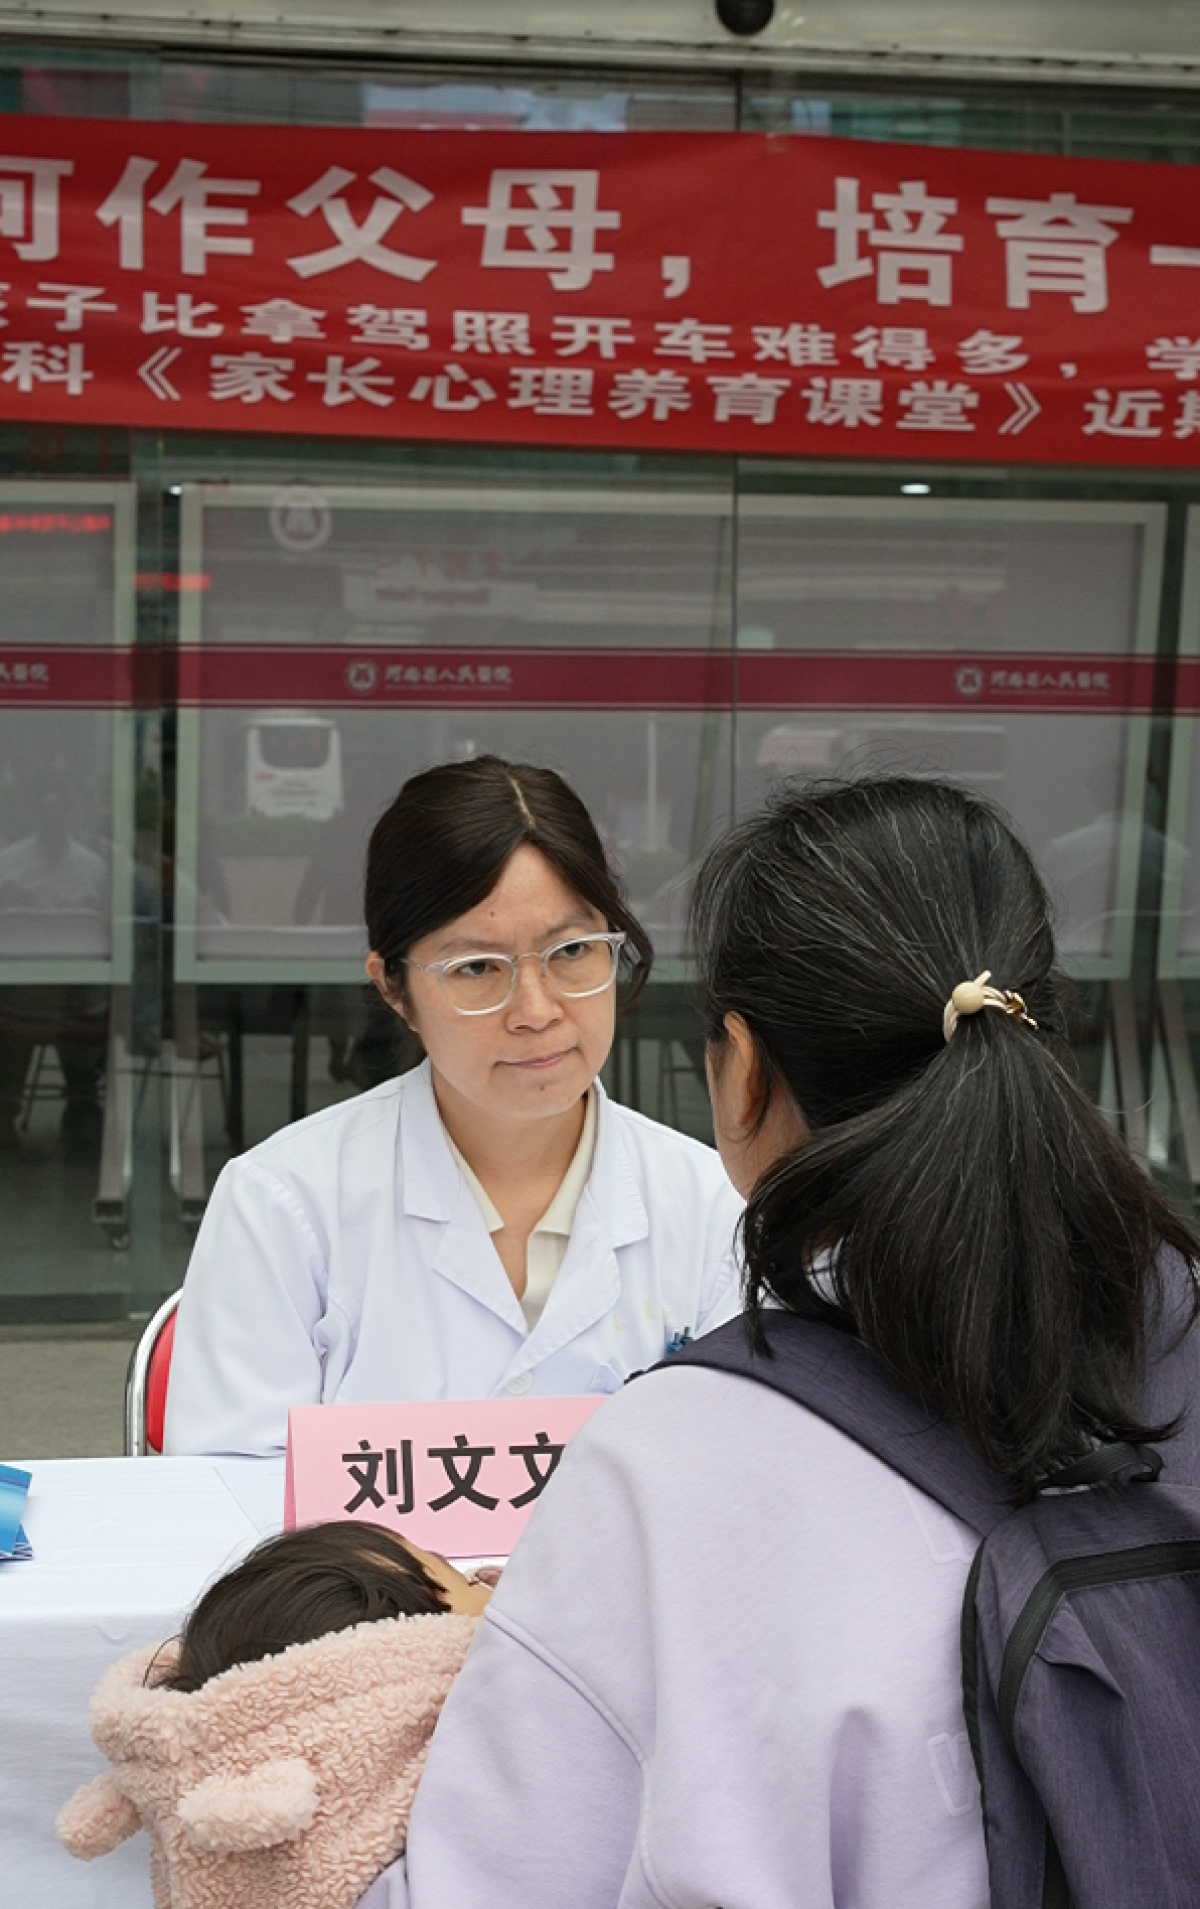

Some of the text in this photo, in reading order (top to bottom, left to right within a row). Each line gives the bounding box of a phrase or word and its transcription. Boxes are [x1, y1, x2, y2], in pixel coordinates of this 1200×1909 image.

[0, 281, 1200, 380] 子比拿驾照开车难得多，学
[341, 1432, 566, 1514] 刘文文
